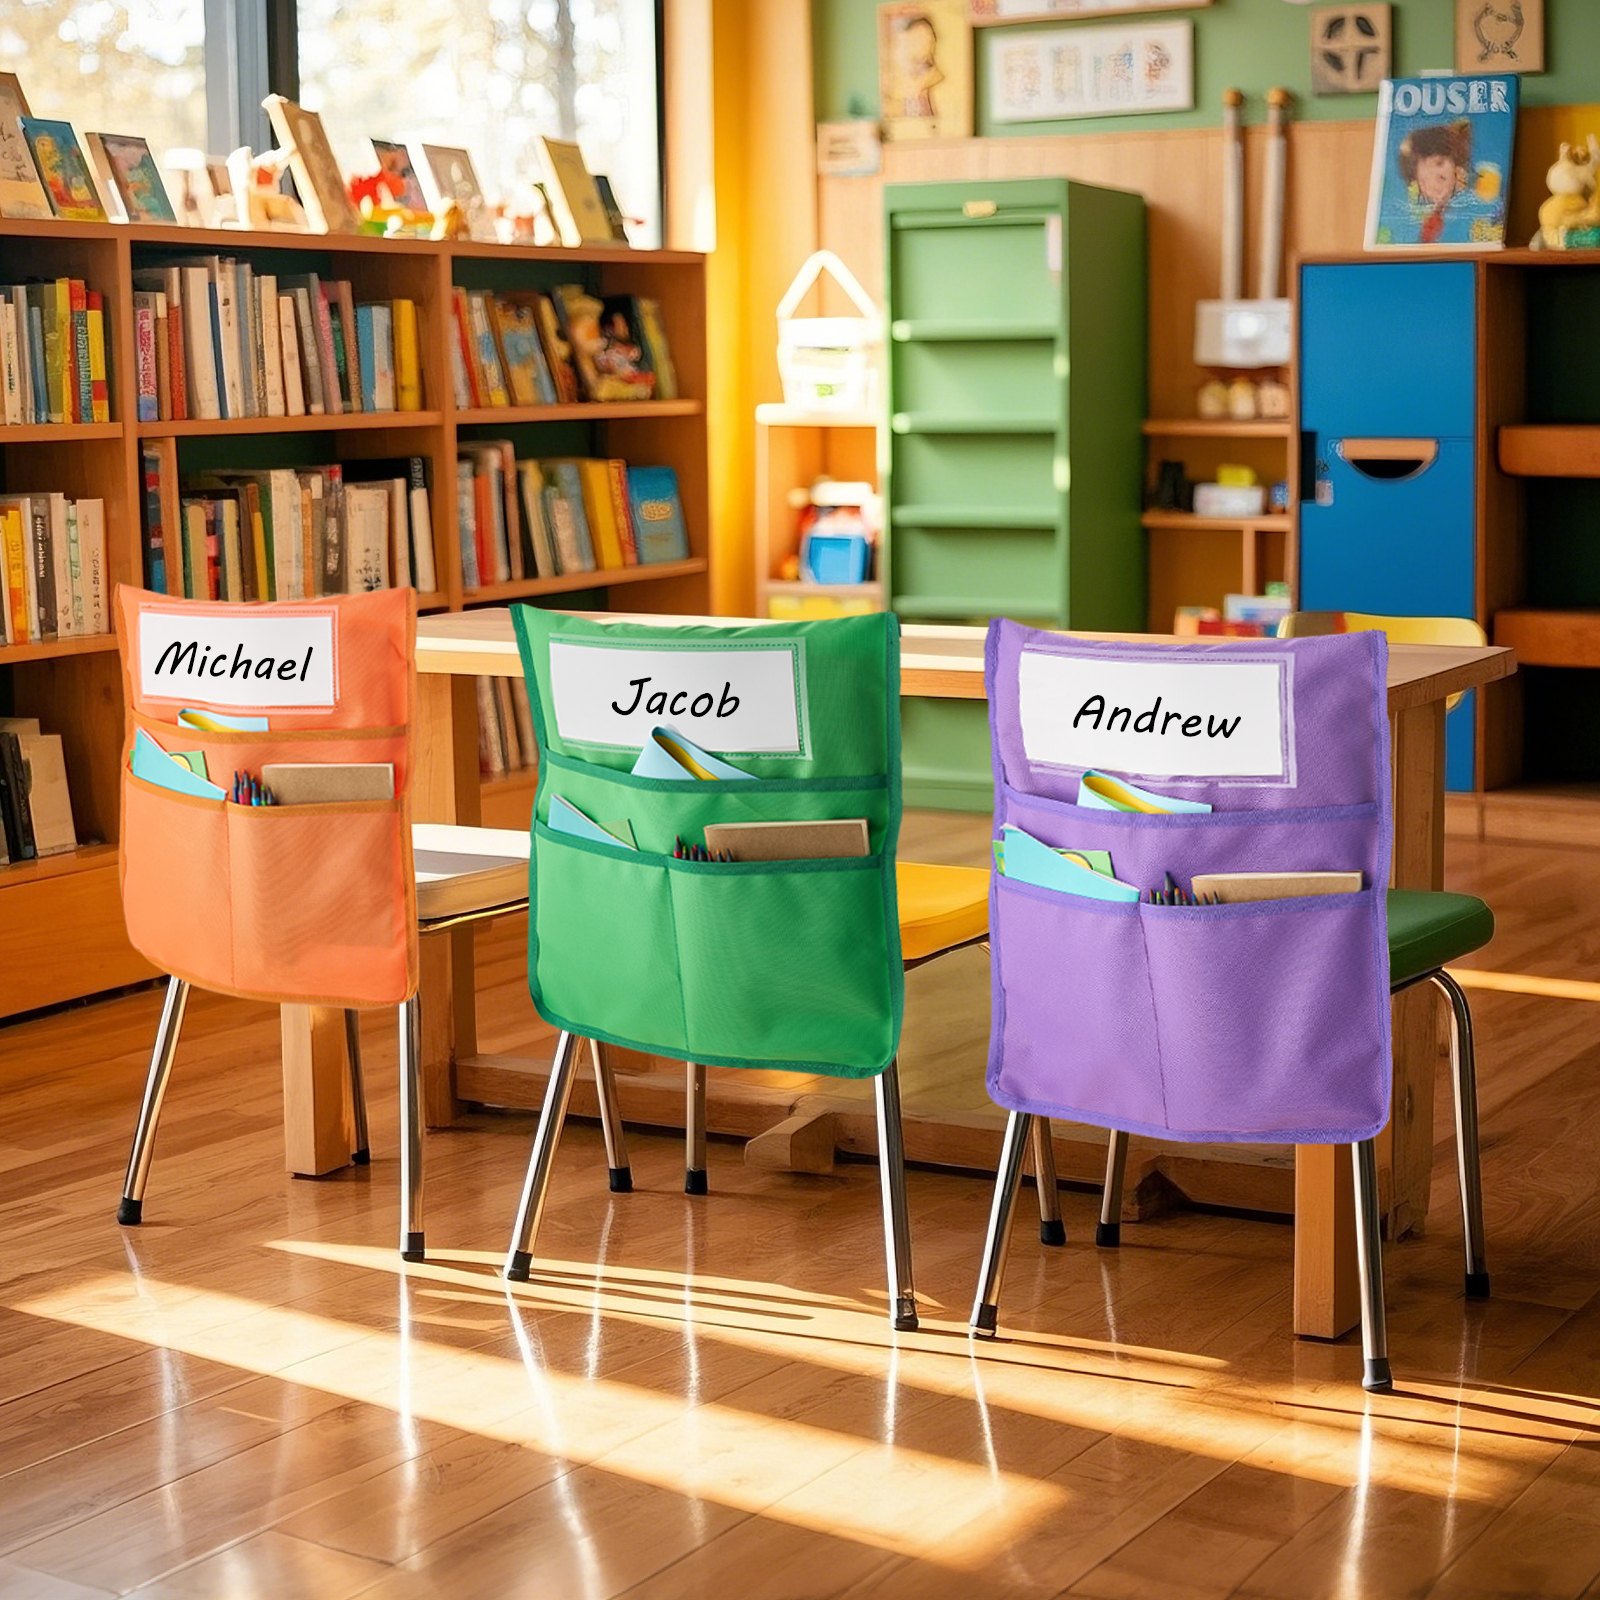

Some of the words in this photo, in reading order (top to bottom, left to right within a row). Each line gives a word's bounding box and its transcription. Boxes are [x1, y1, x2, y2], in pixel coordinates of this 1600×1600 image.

[155, 642, 313, 681] Michael
[612, 677, 740, 718] Jacob
[1073, 695, 1242, 738] Andrew
